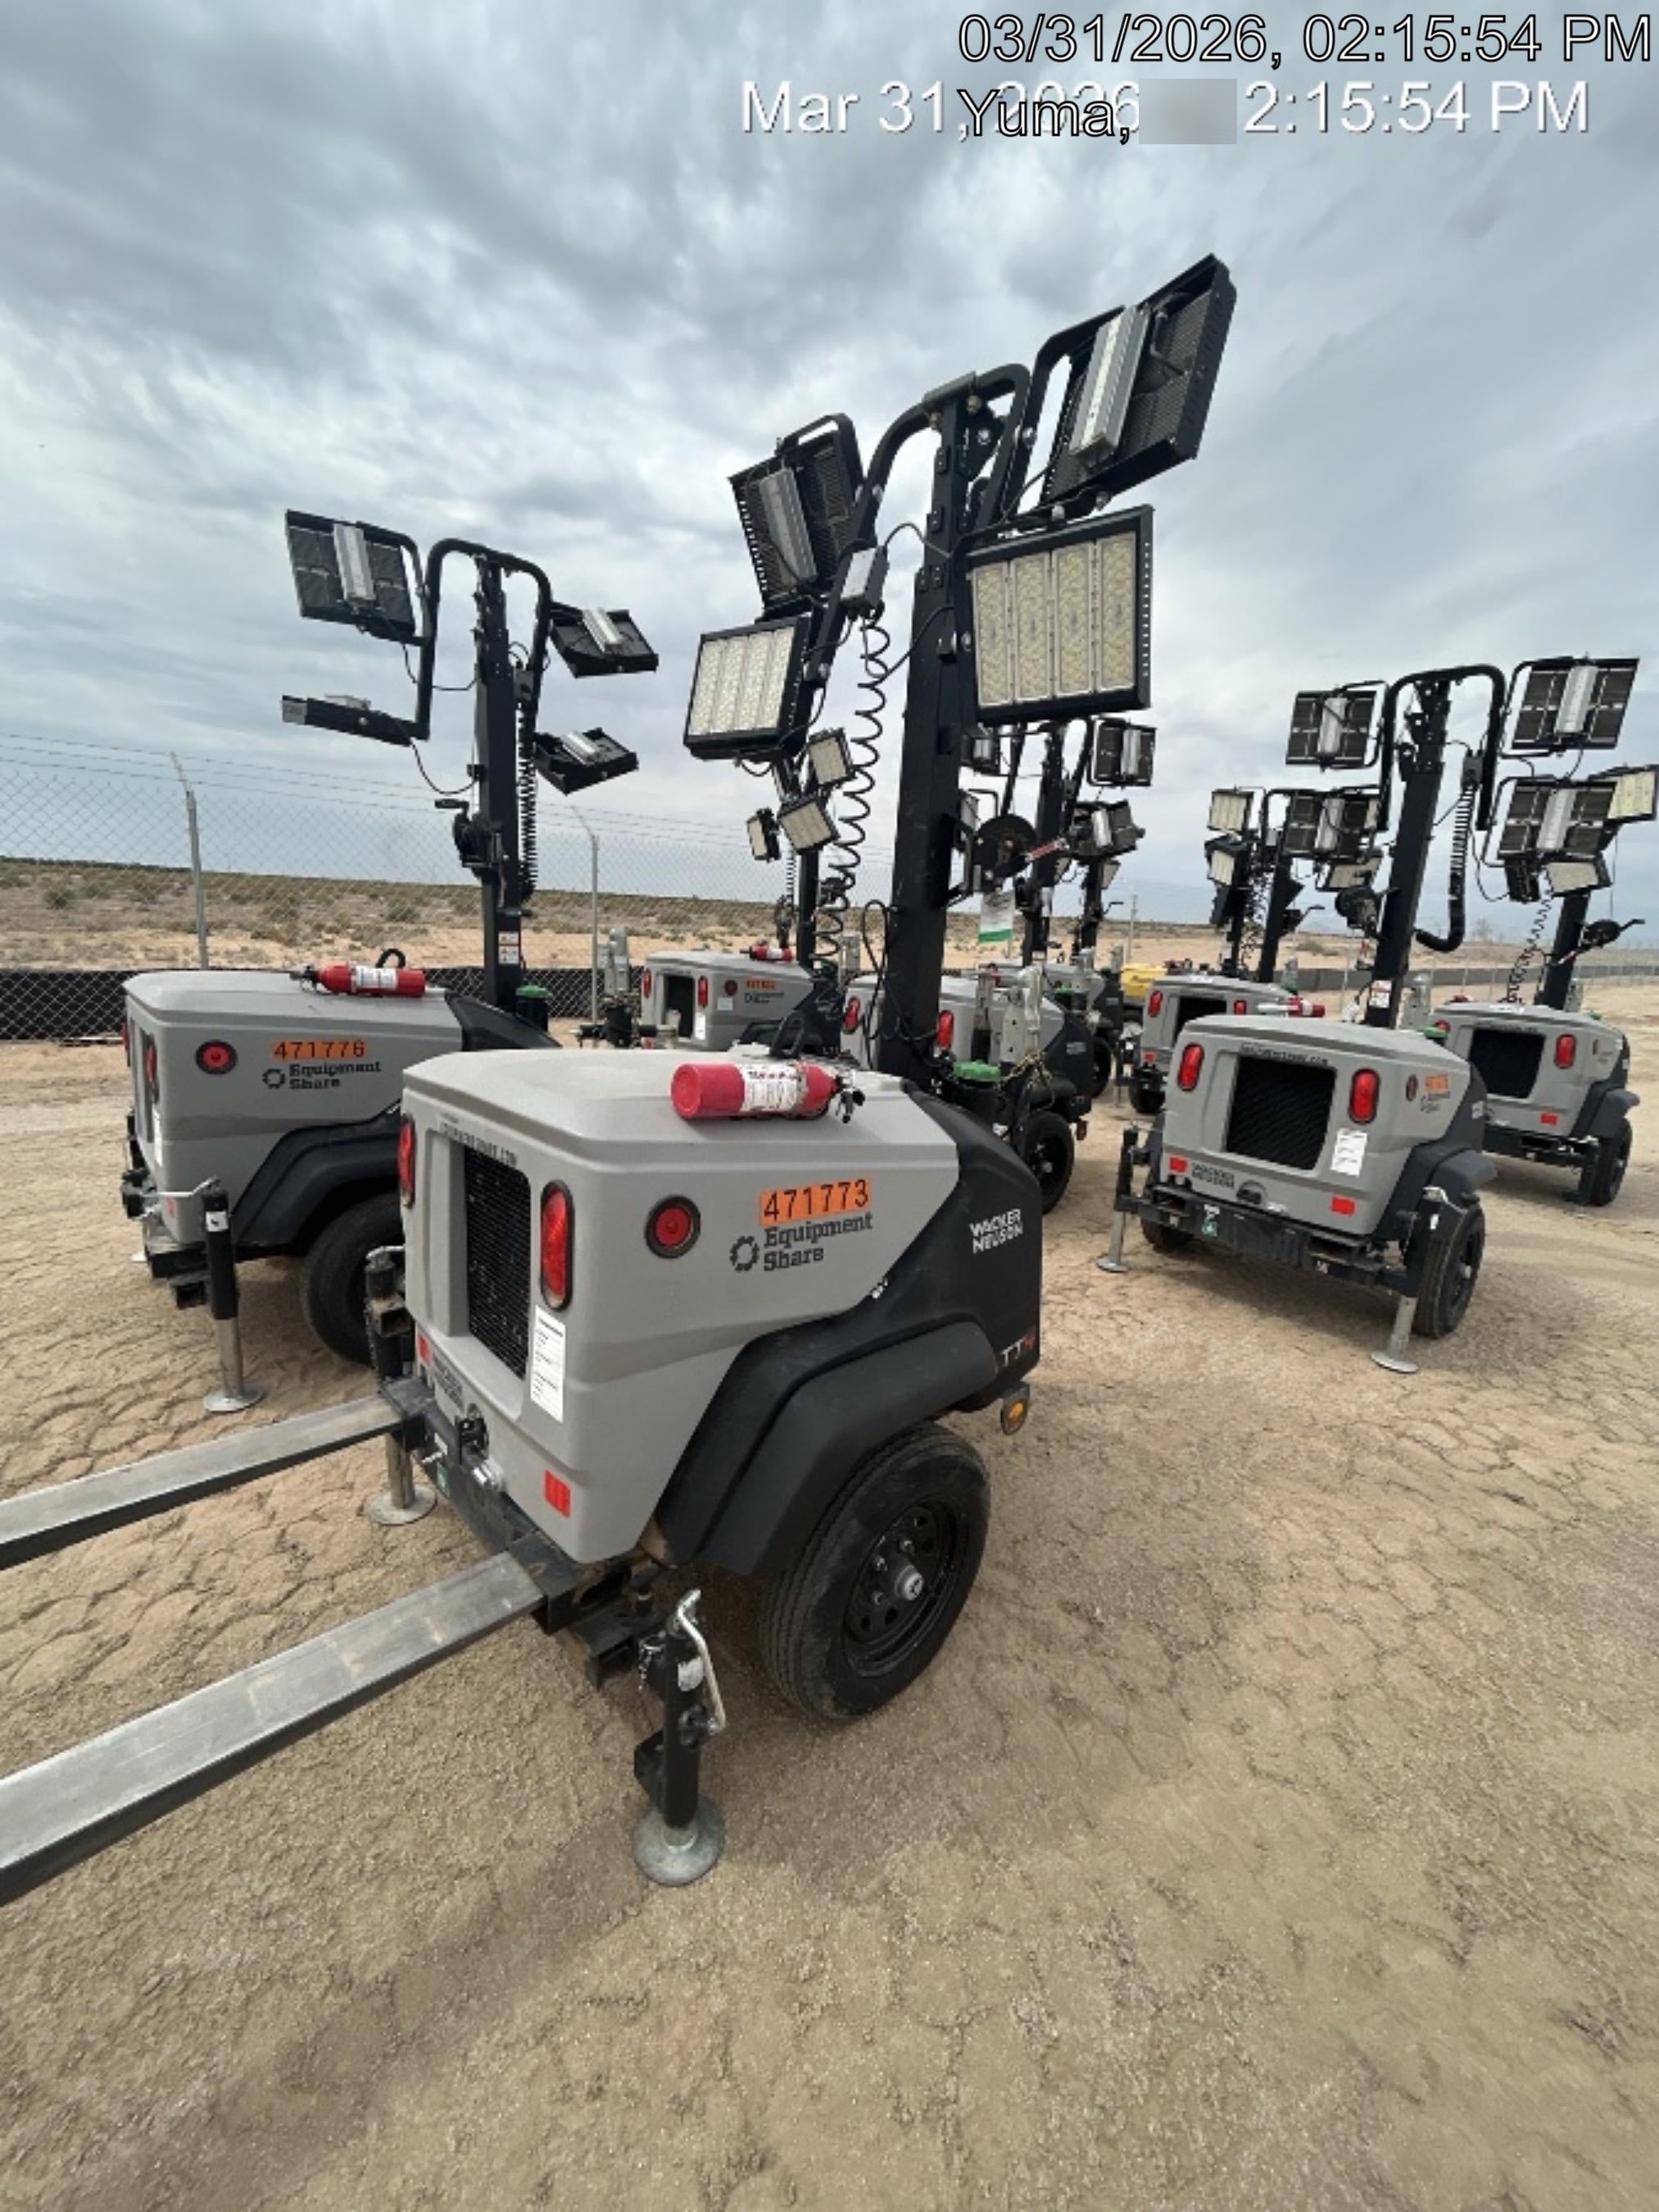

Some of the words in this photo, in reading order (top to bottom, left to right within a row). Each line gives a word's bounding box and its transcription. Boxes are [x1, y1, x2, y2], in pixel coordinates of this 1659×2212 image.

[274, 1039, 366, 1060] 471776
[764, 1178, 869, 1222] 471773
[764, 1212, 873, 1249] Equipment
[968, 1208, 1022, 1238] WACKER
[972, 1222, 1023, 1254] NEUSON
[764, 1247, 824, 1272] Share
